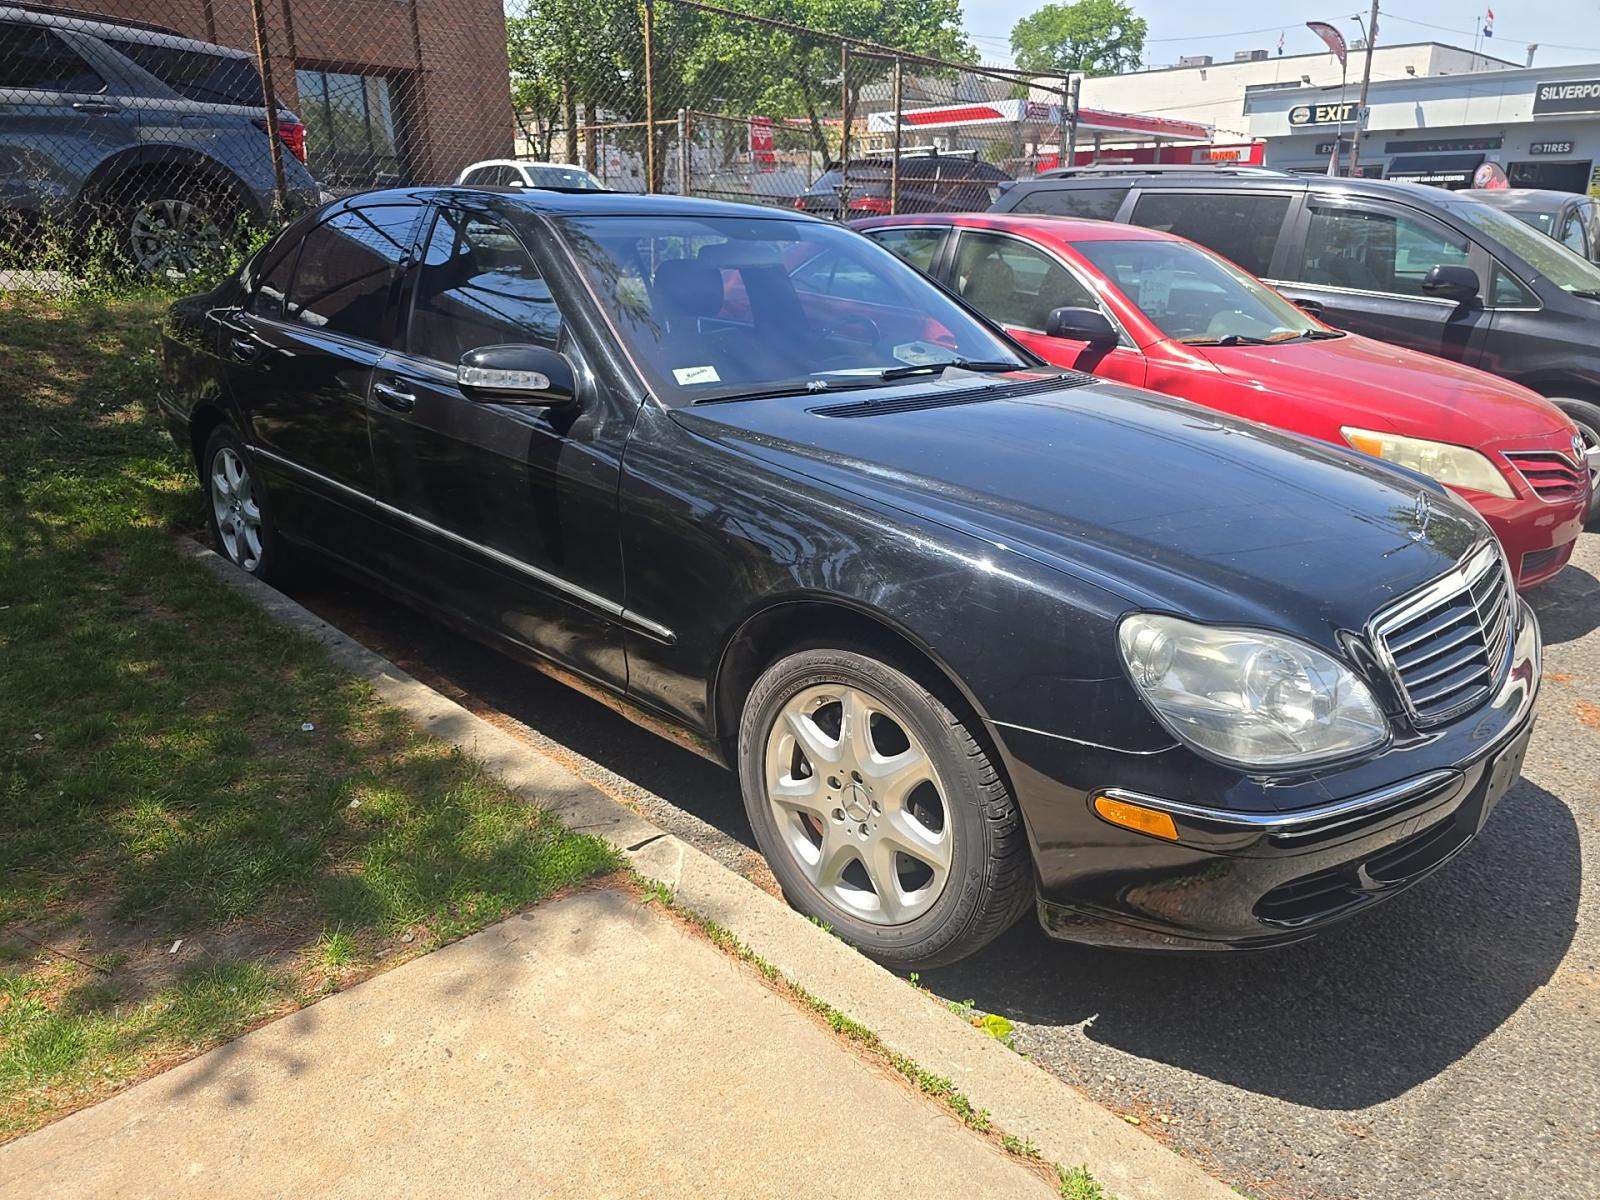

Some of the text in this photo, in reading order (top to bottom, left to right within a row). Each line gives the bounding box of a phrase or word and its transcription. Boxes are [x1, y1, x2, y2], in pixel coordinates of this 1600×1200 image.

[1541, 84, 1600, 100] SILVERPO
[1315, 105, 1353, 121] EXIT
[1543, 143, 1571, 153] TIRES
